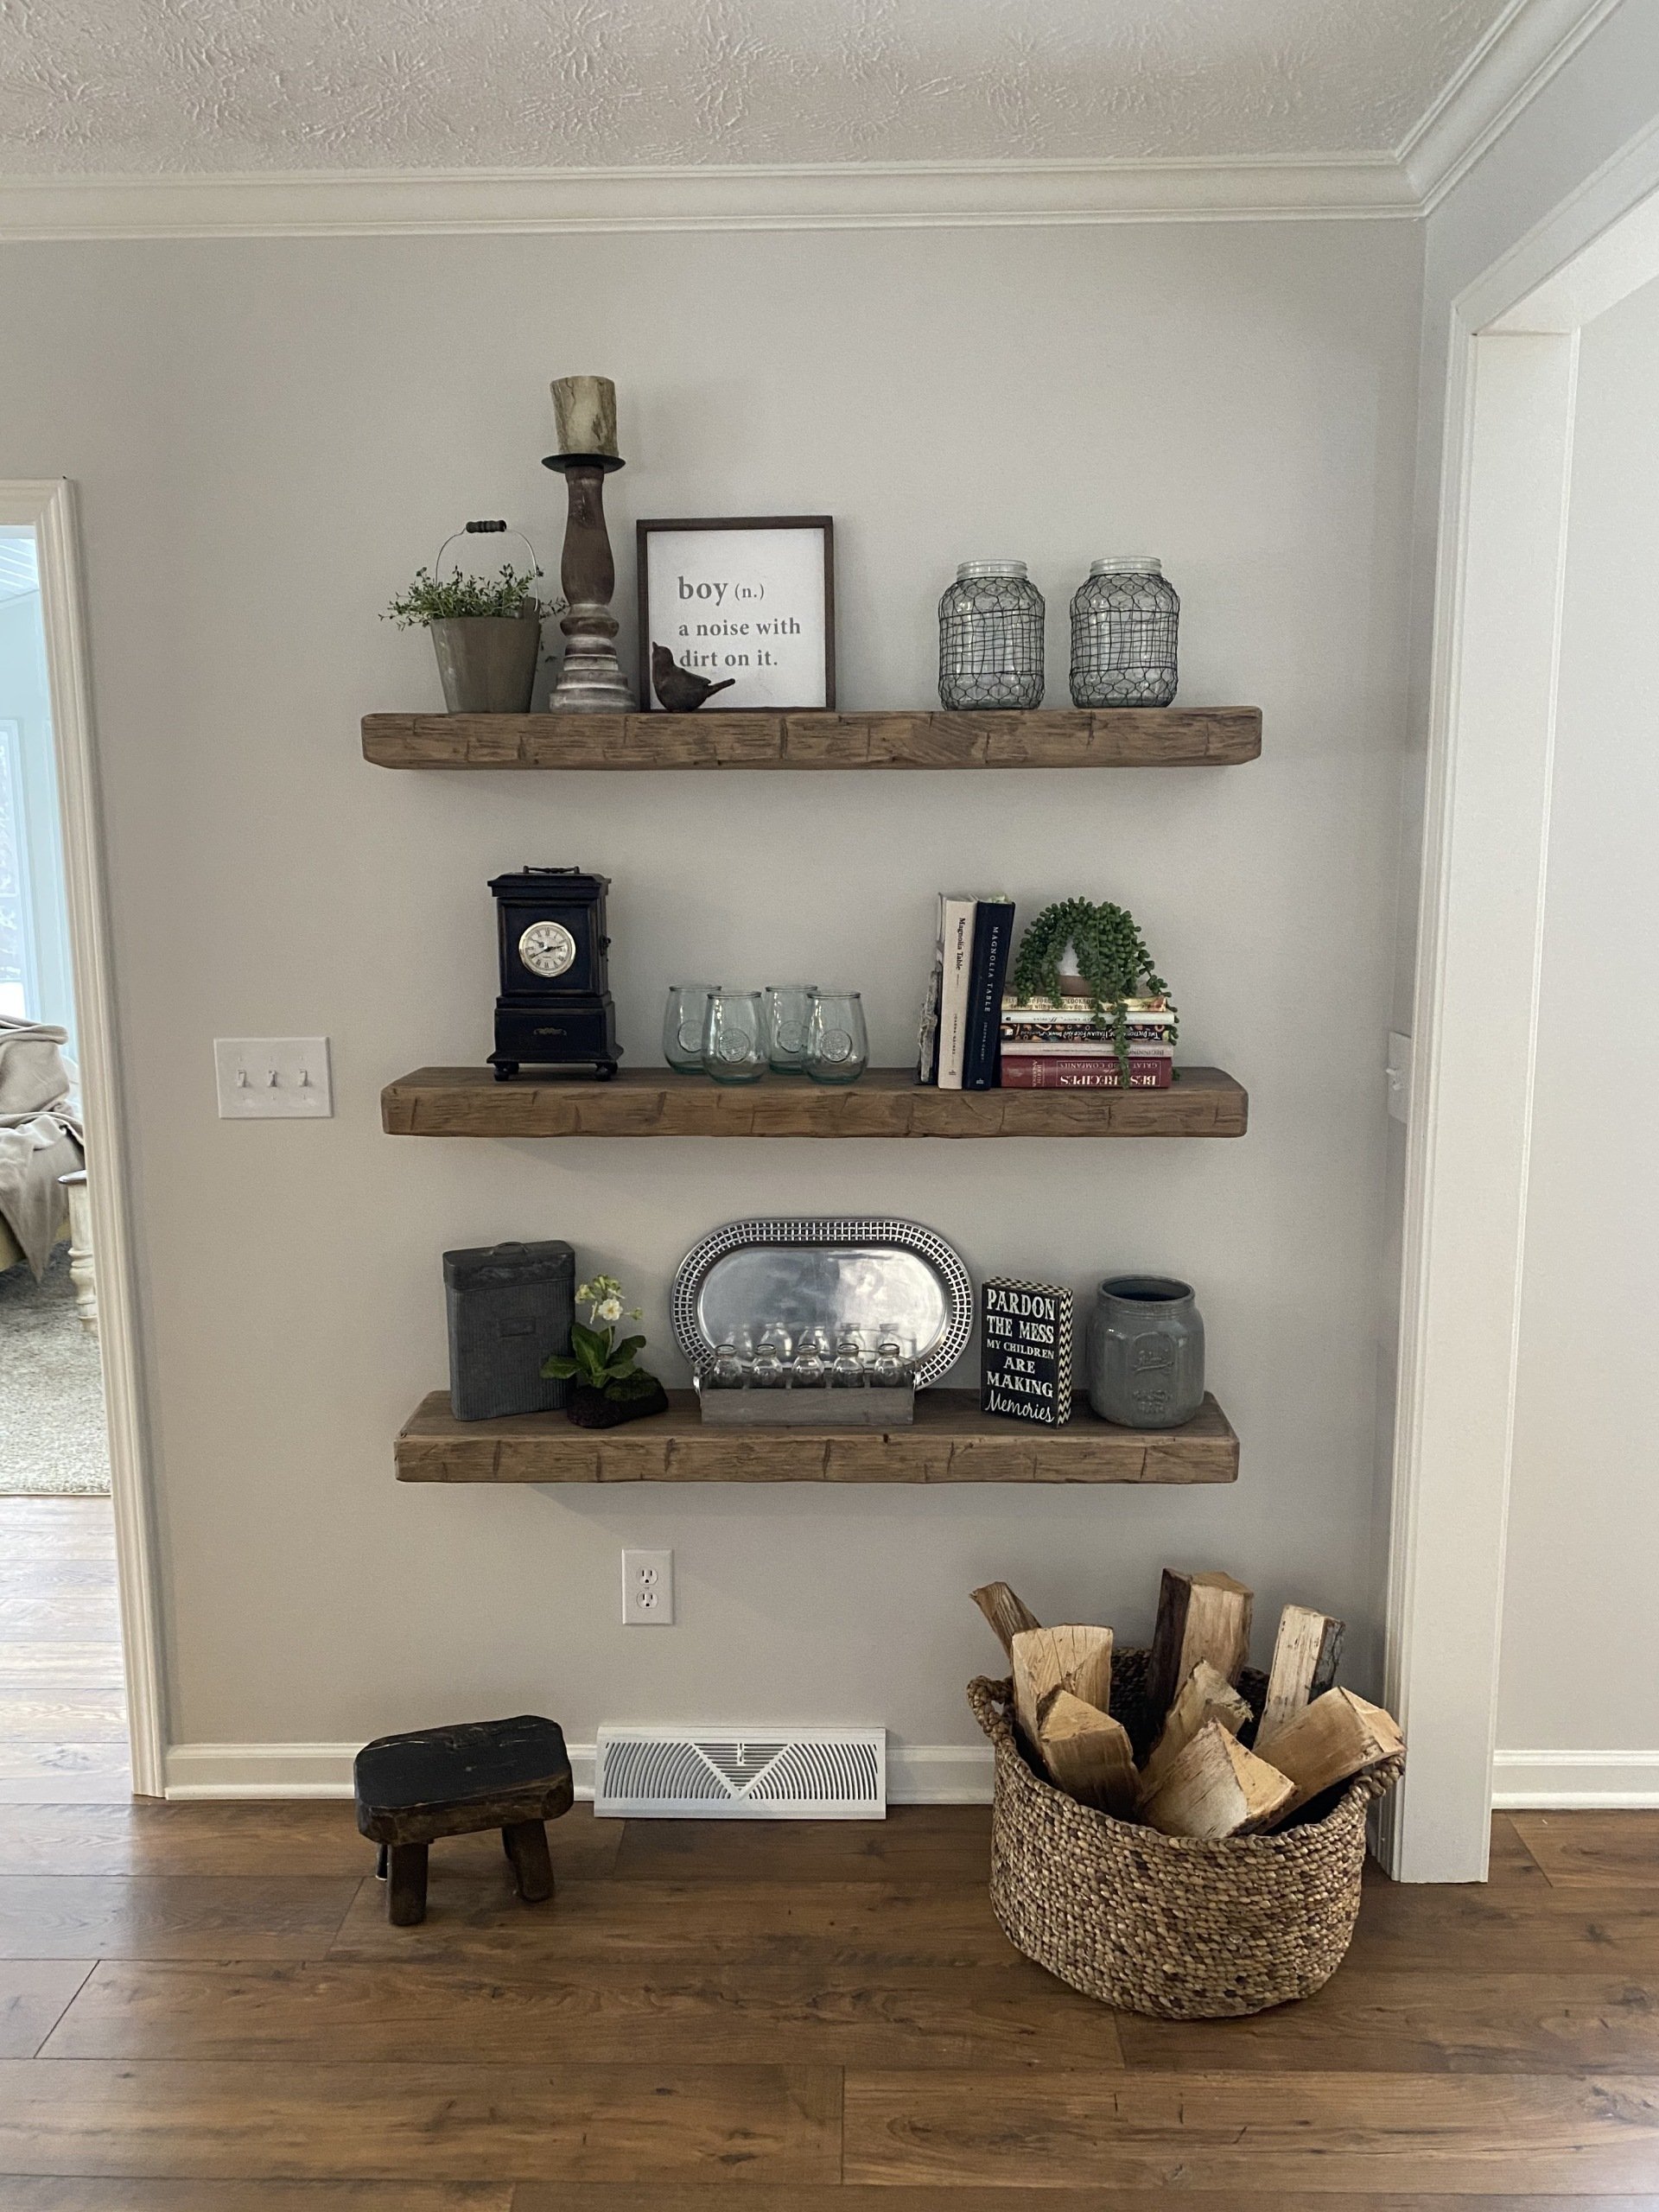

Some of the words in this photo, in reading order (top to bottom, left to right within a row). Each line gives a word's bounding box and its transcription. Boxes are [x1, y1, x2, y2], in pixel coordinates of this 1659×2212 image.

[677, 575, 728, 607] boy
[734, 582, 765, 601] (n.)
[678, 624, 690, 637] a
[696, 620, 749, 636] noise
[755, 617, 801, 635] with
[679, 650, 718, 667] dirt
[724, 653, 750, 666] on
[757, 650, 779, 666] it.
[957, 918, 966, 950] Magnolia
[956, 951, 964, 970] Table
[988, 926, 1000, 978] MAGNOLIA
[984, 983, 993, 1013] TABLE
[1148, 1032, 1160, 1040] THE
[1060, 1075, 1118, 1085] RECIPES
[1130, 1075, 1156, 1085] BES
[987, 1288, 1055, 1321] PARDON
[986, 1315, 1013, 1337] THE
[1019, 1320, 1054, 1344] MESS
[987, 1338, 1001, 1350] MY
[1003, 1342, 1054, 1360] CHILDREN
[1002, 1356, 1035, 1374] ARE
[987, 1370, 1053, 1398] MAKING
[985, 1389, 1054, 1423] Memories
